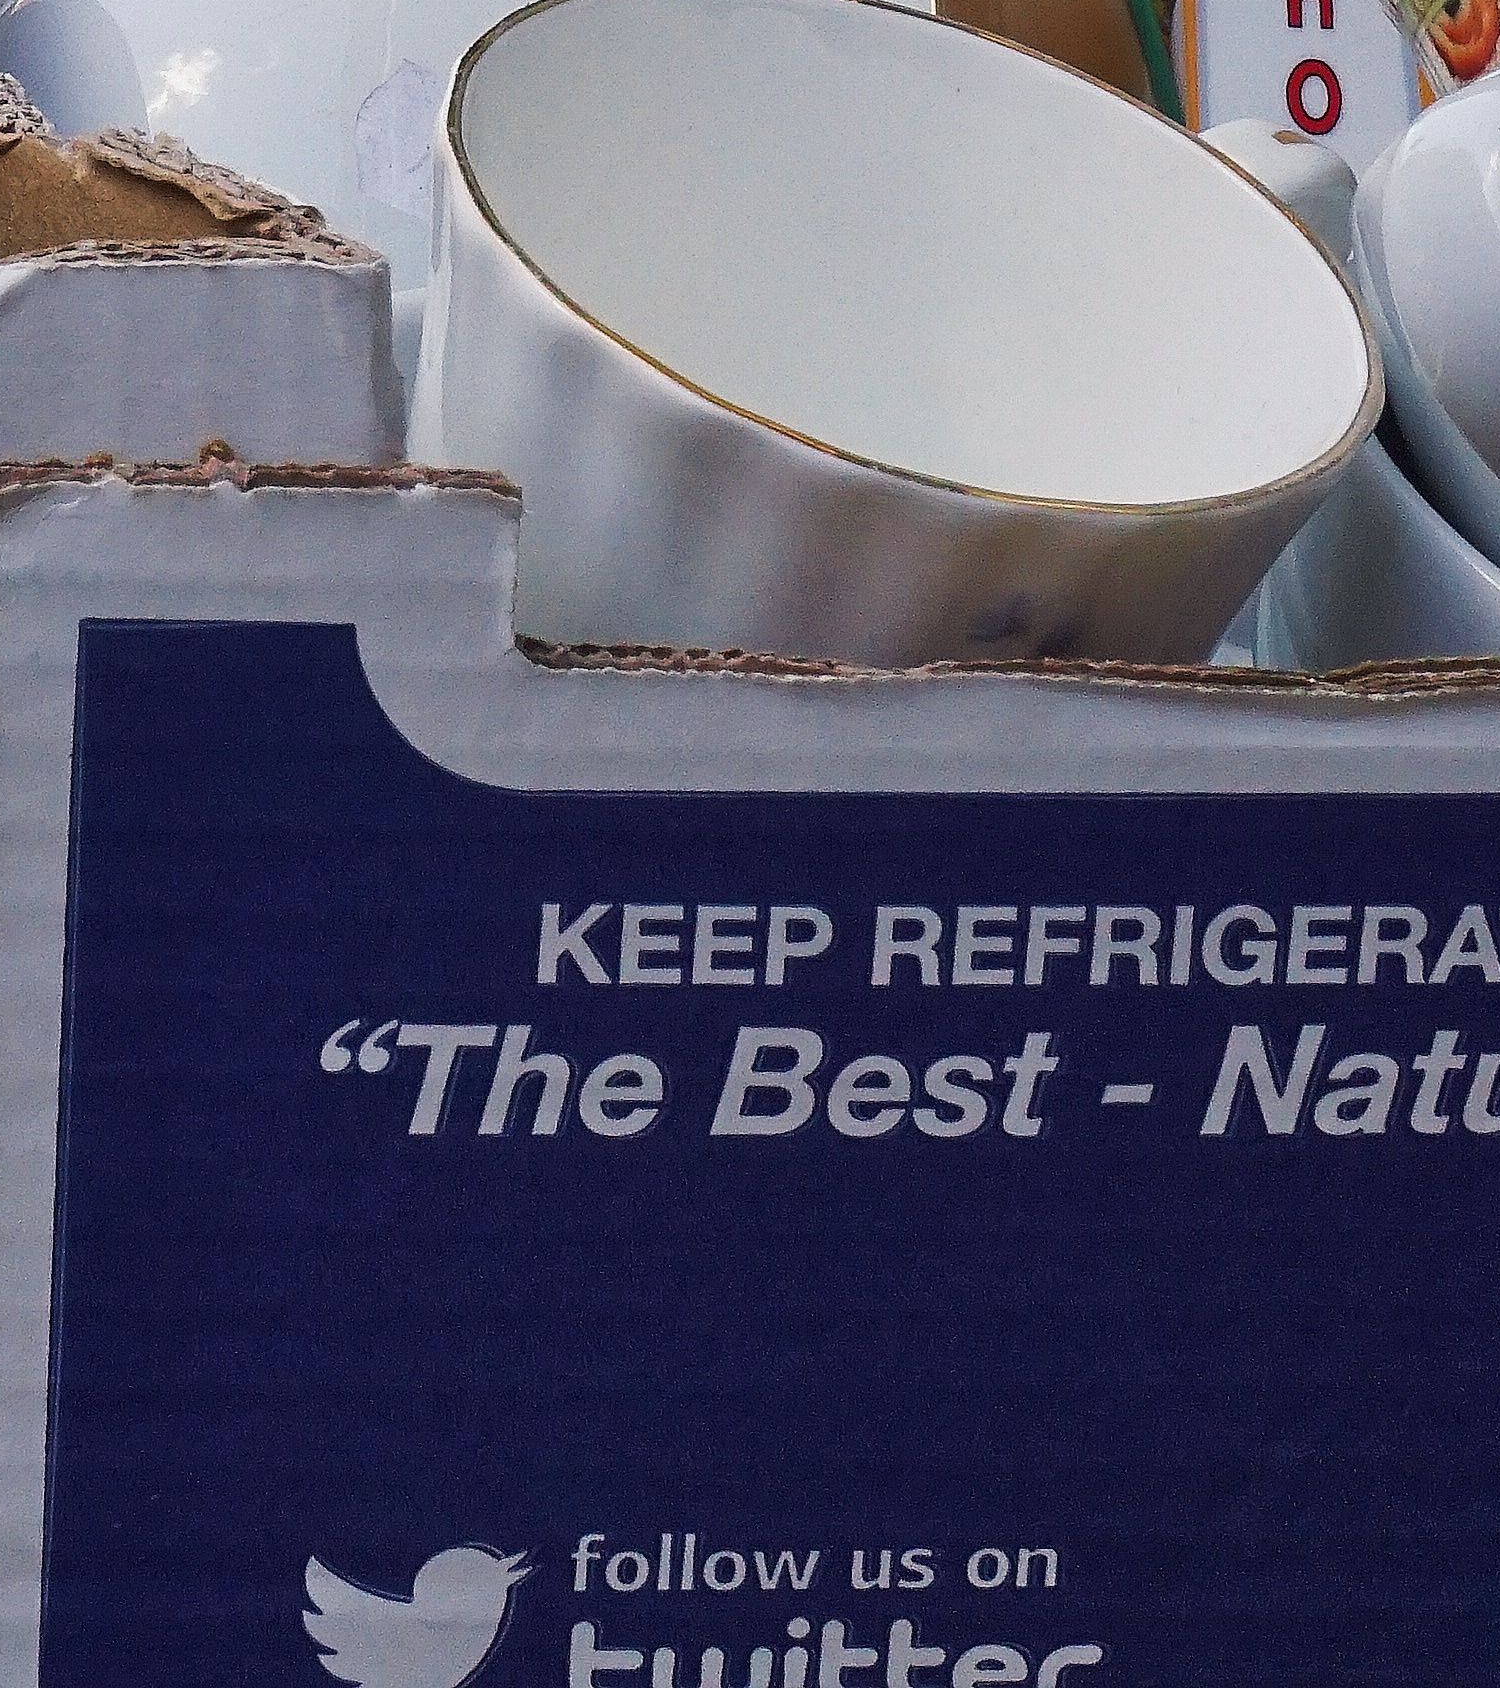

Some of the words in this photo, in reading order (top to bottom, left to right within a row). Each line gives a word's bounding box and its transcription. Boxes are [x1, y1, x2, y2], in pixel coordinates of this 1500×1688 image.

[535, 902, 834, 987] KEEP
[318, 1017, 667, 1139] “The
[709, 1024, 1060, 1139] Best
[1100, 1082, 1155, 1106] -
[571, 1532, 820, 1593] follow
[850, 1546, 936, 1592] us
[964, 1545, 1060, 1590] on
